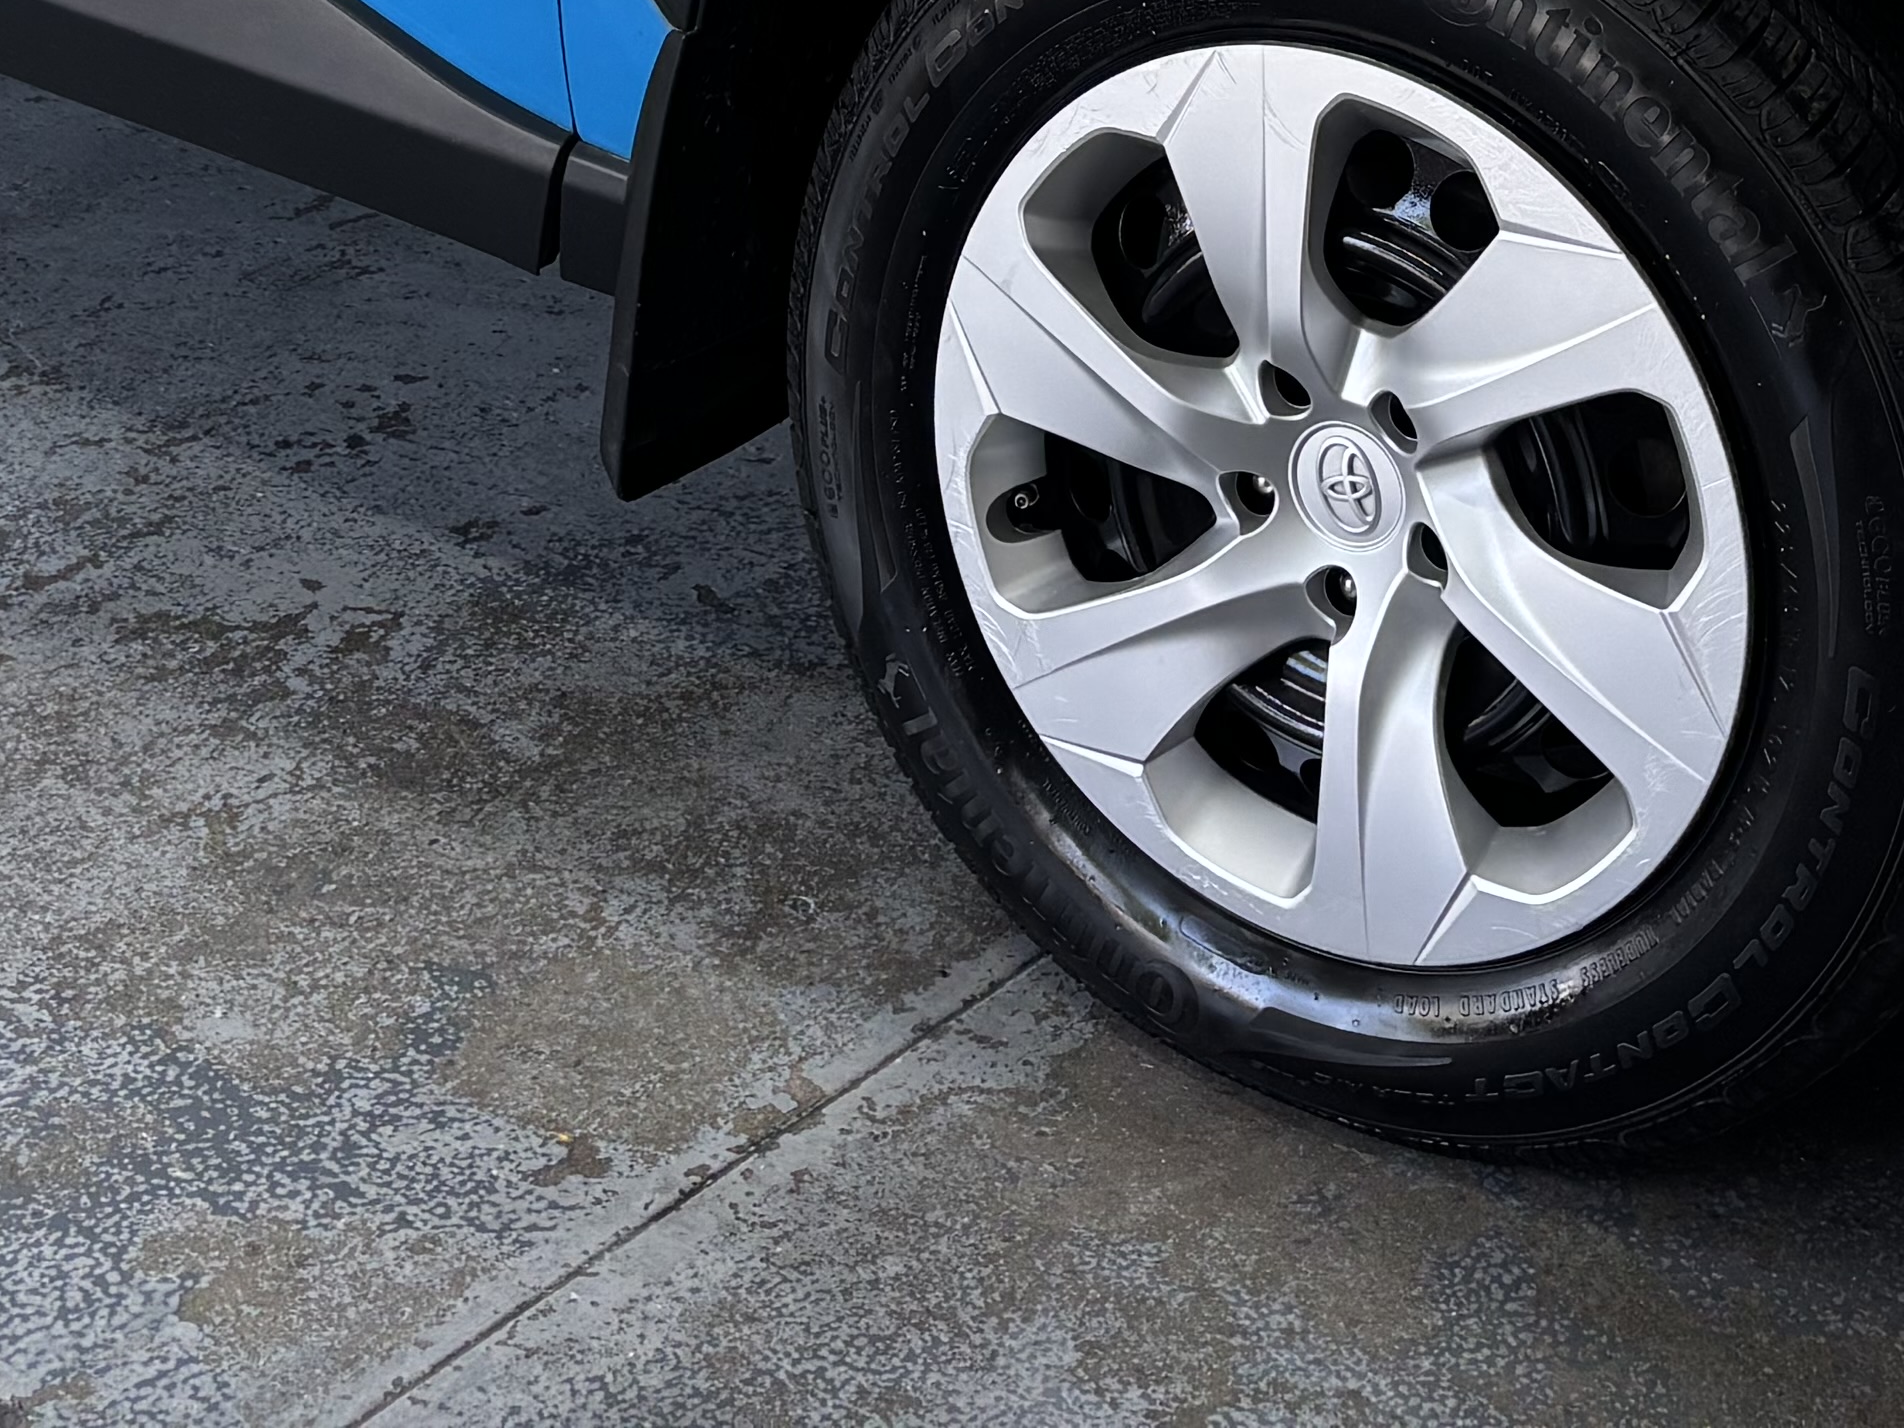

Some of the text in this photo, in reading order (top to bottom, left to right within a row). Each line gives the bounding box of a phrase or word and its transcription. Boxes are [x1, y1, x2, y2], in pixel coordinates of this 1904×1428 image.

[1466, 663, 1878, 1101] CONTROL CONTACT
[1390, 992, 1443, 1017] LOAD
[1455, 973, 1565, 1021] STANDARD
